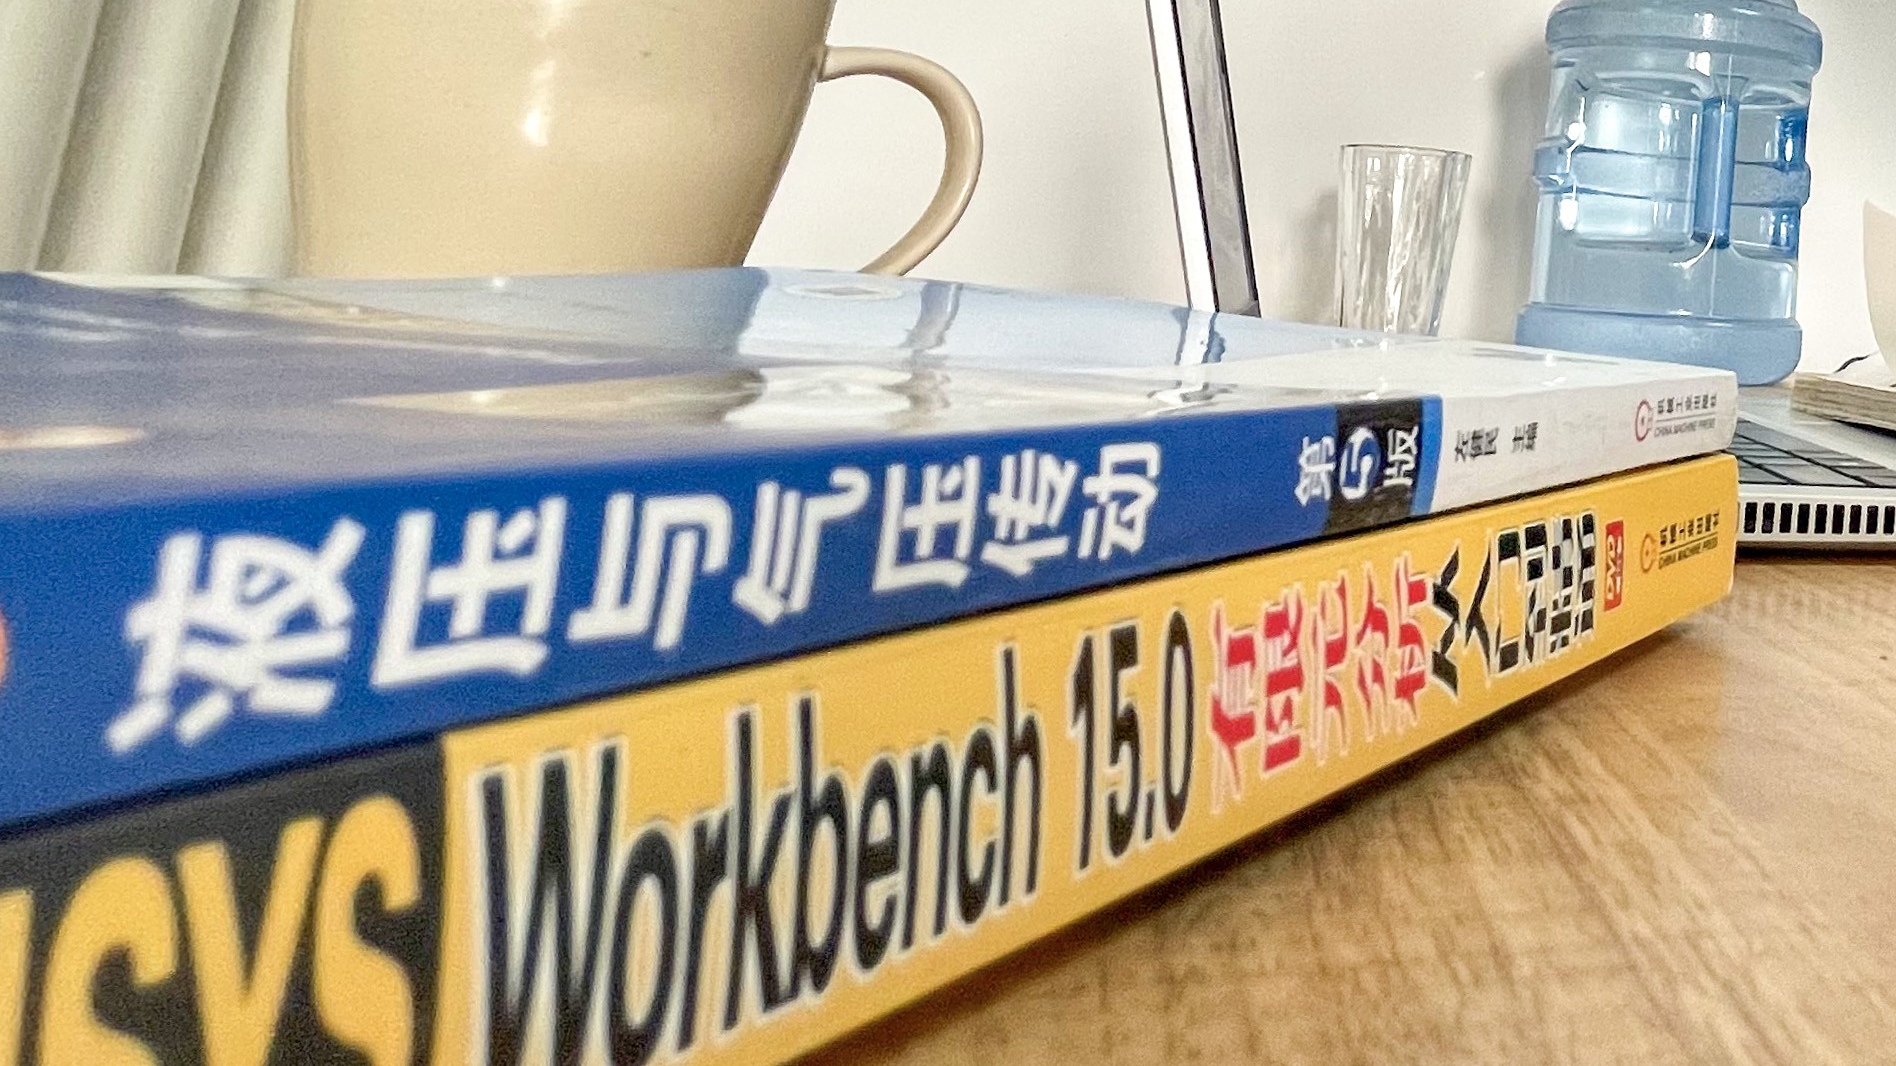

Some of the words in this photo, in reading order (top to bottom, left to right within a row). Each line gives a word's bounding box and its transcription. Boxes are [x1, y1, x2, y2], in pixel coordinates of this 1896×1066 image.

[105, 440, 1163, 753] 液压与气压传动
[0, 795, 422, 1066] SYS
[480, 646, 1042, 1066] Workbench
[1070, 610, 1194, 870] 15.0
